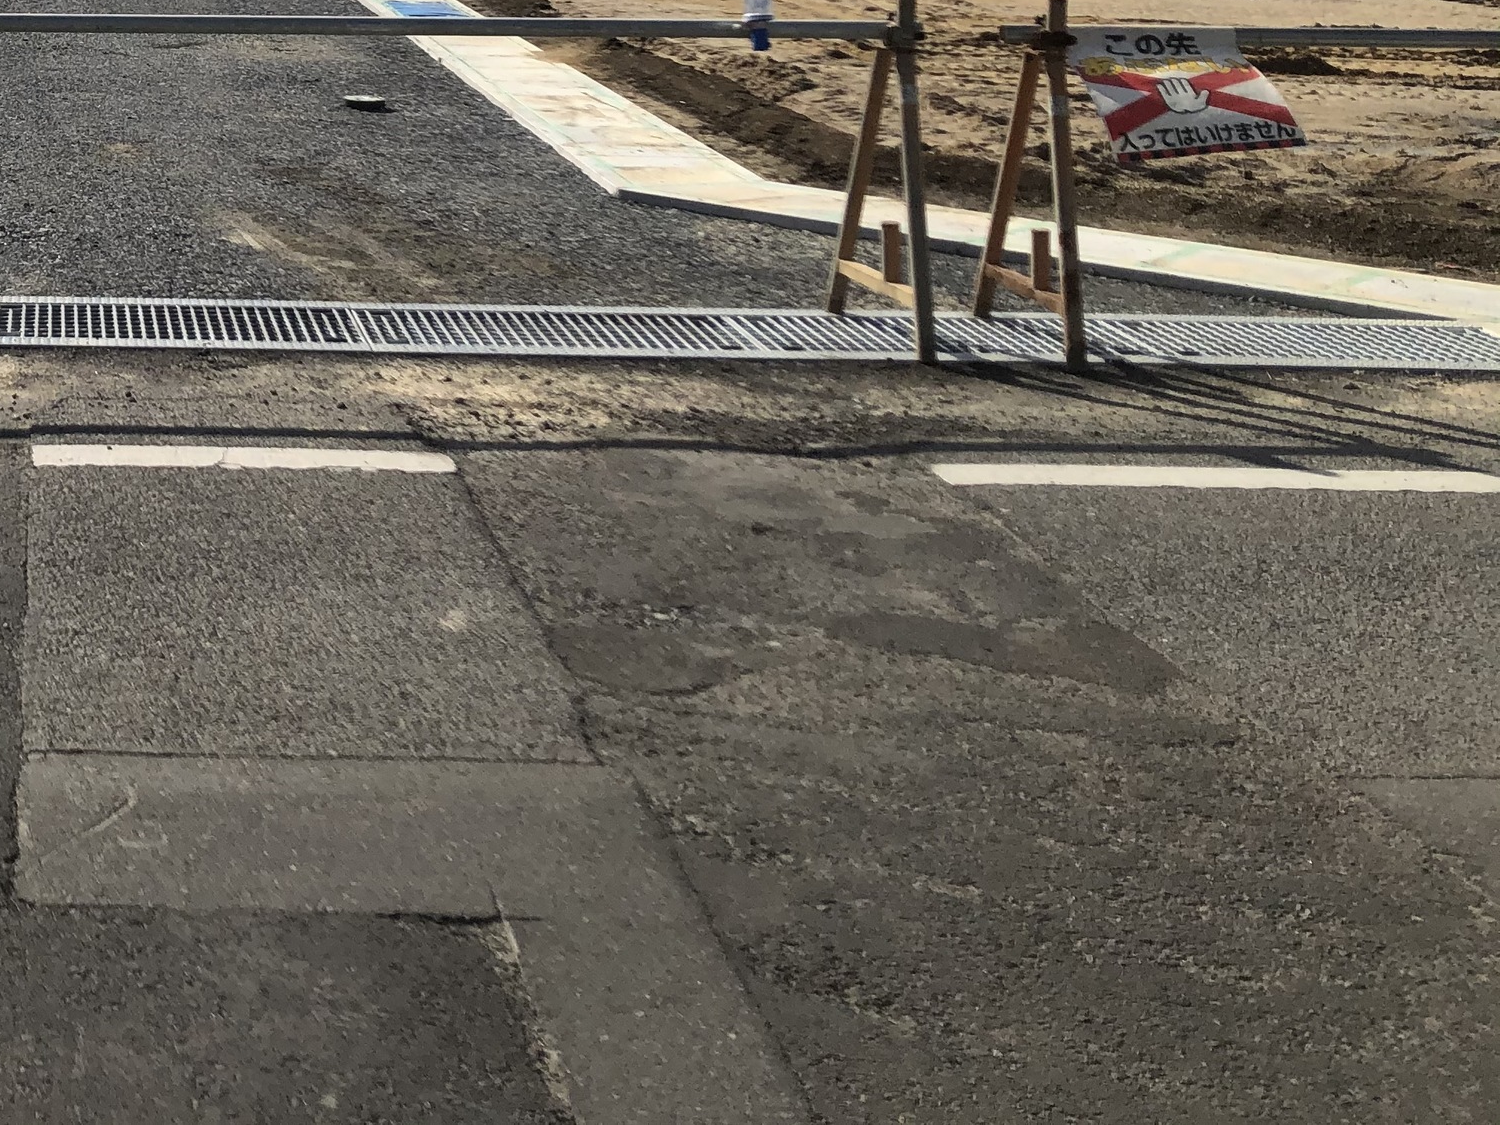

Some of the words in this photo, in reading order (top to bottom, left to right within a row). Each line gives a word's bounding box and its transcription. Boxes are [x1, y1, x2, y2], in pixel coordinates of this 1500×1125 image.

[1105, 32, 1202, 56] この先
[1120, 121, 1296, 152] 入ってはいけません
